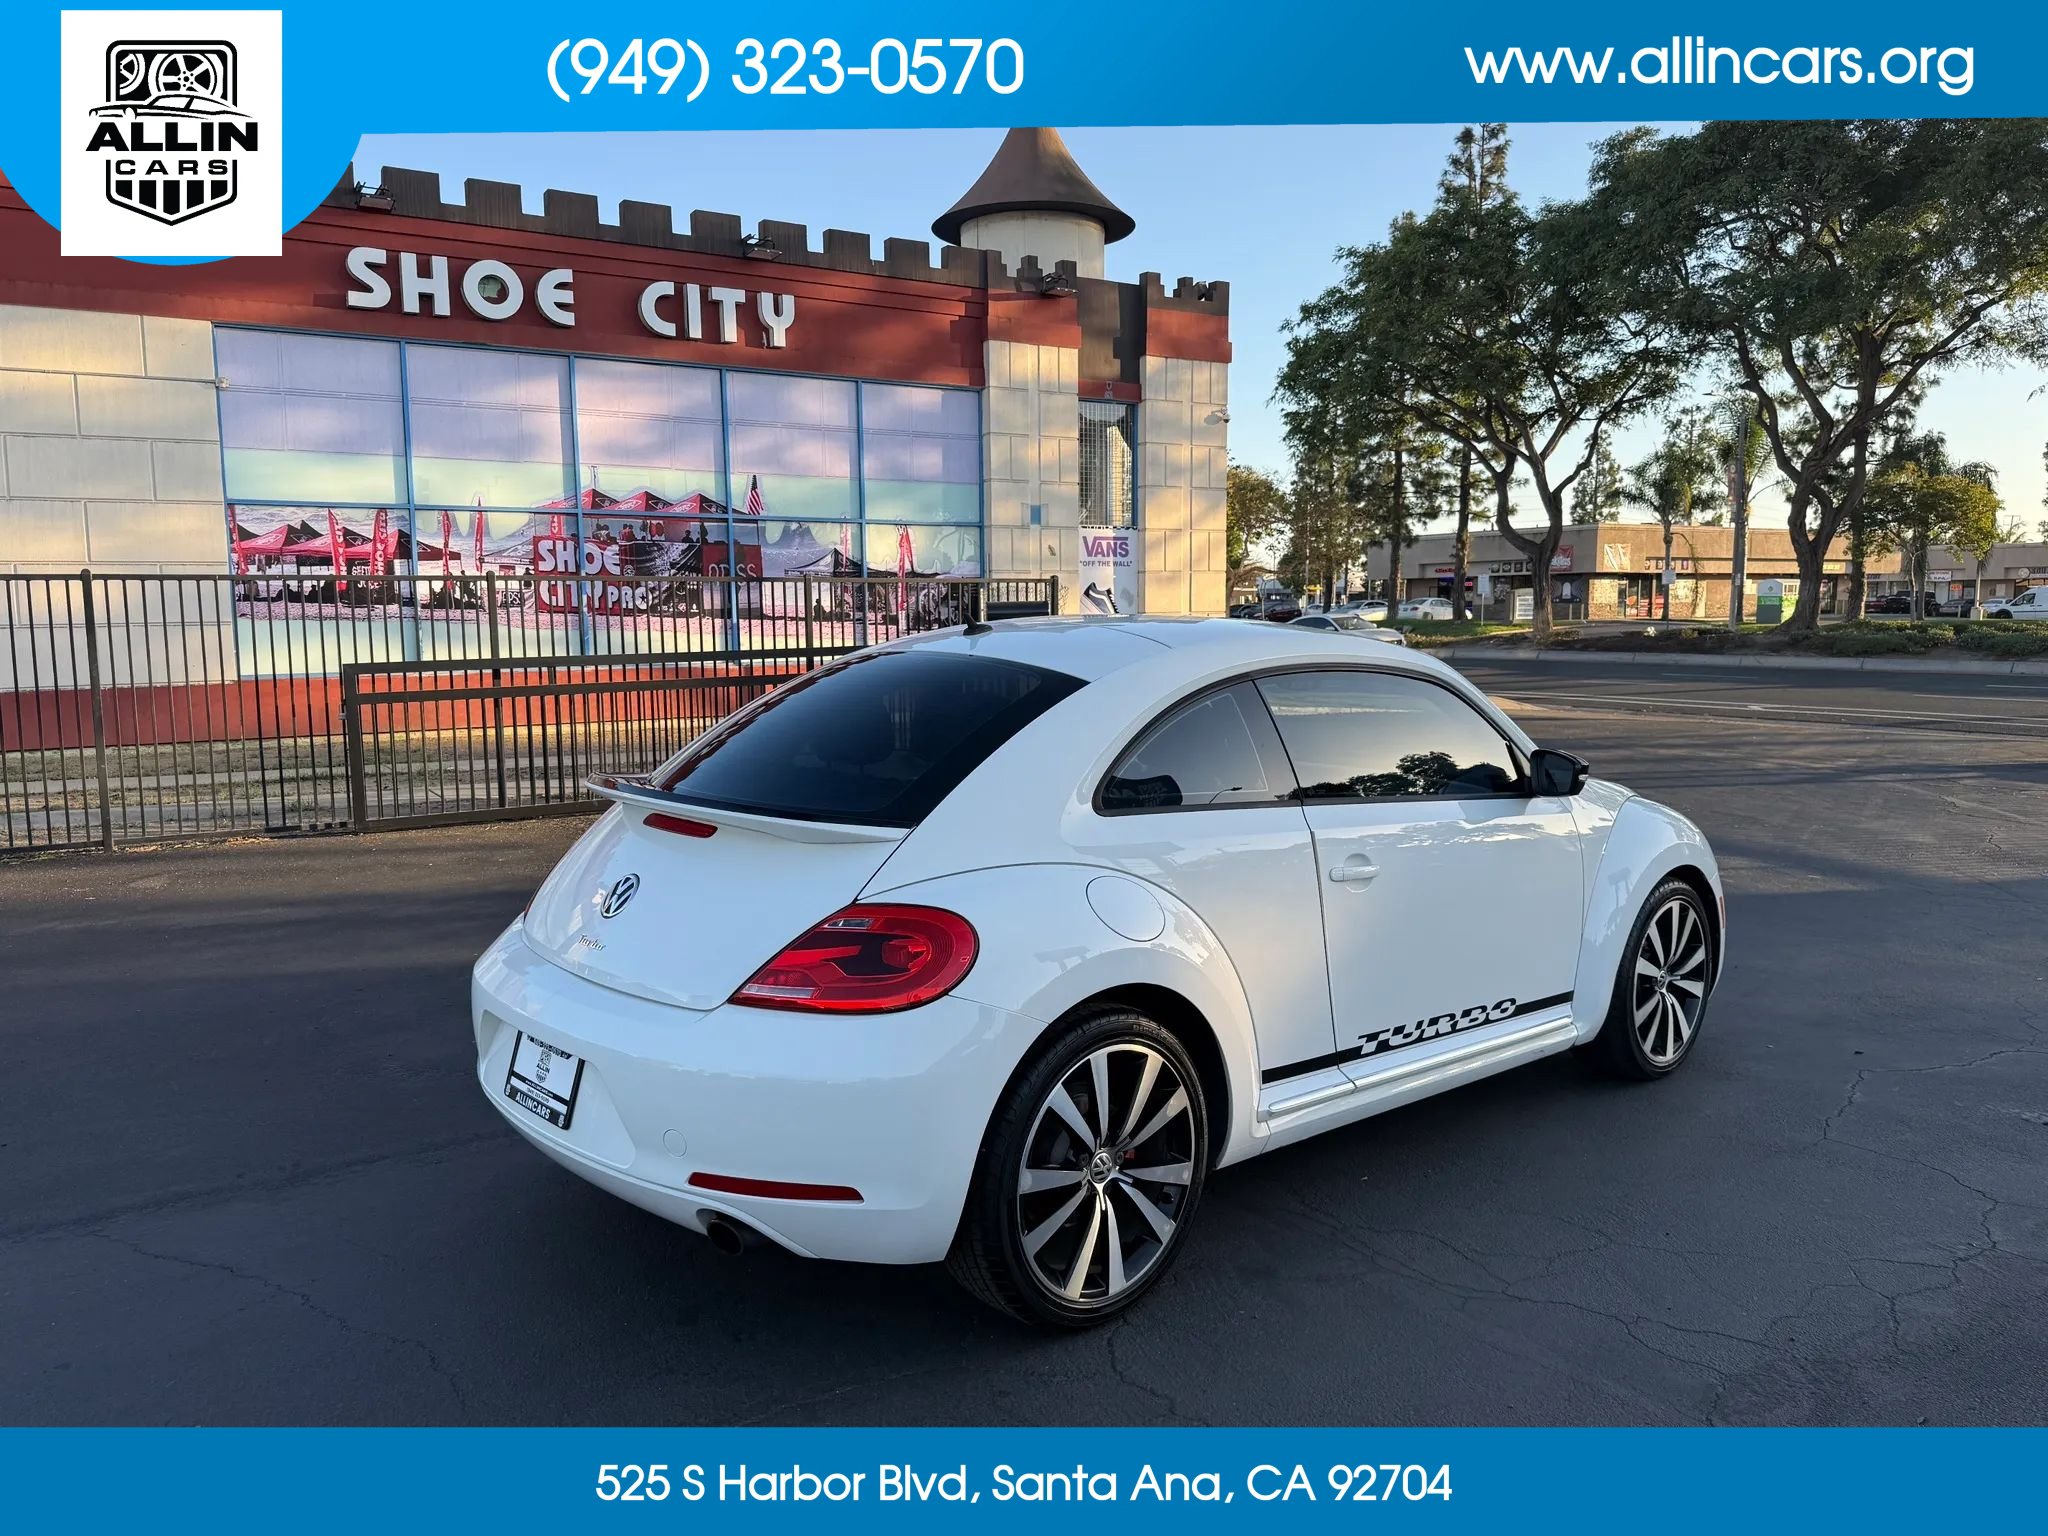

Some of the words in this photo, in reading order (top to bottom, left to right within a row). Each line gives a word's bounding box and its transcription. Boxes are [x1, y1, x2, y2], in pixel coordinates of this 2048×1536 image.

[345, 246, 576, 327] SHOE
[638, 281, 796, 348] CITY
[538, 539, 621, 576] SHOE
[1082, 536, 1129, 558] VANS
[1357, 997, 1517, 1055] TURBO
[515, 1092, 551, 1119] ALLINCARS
